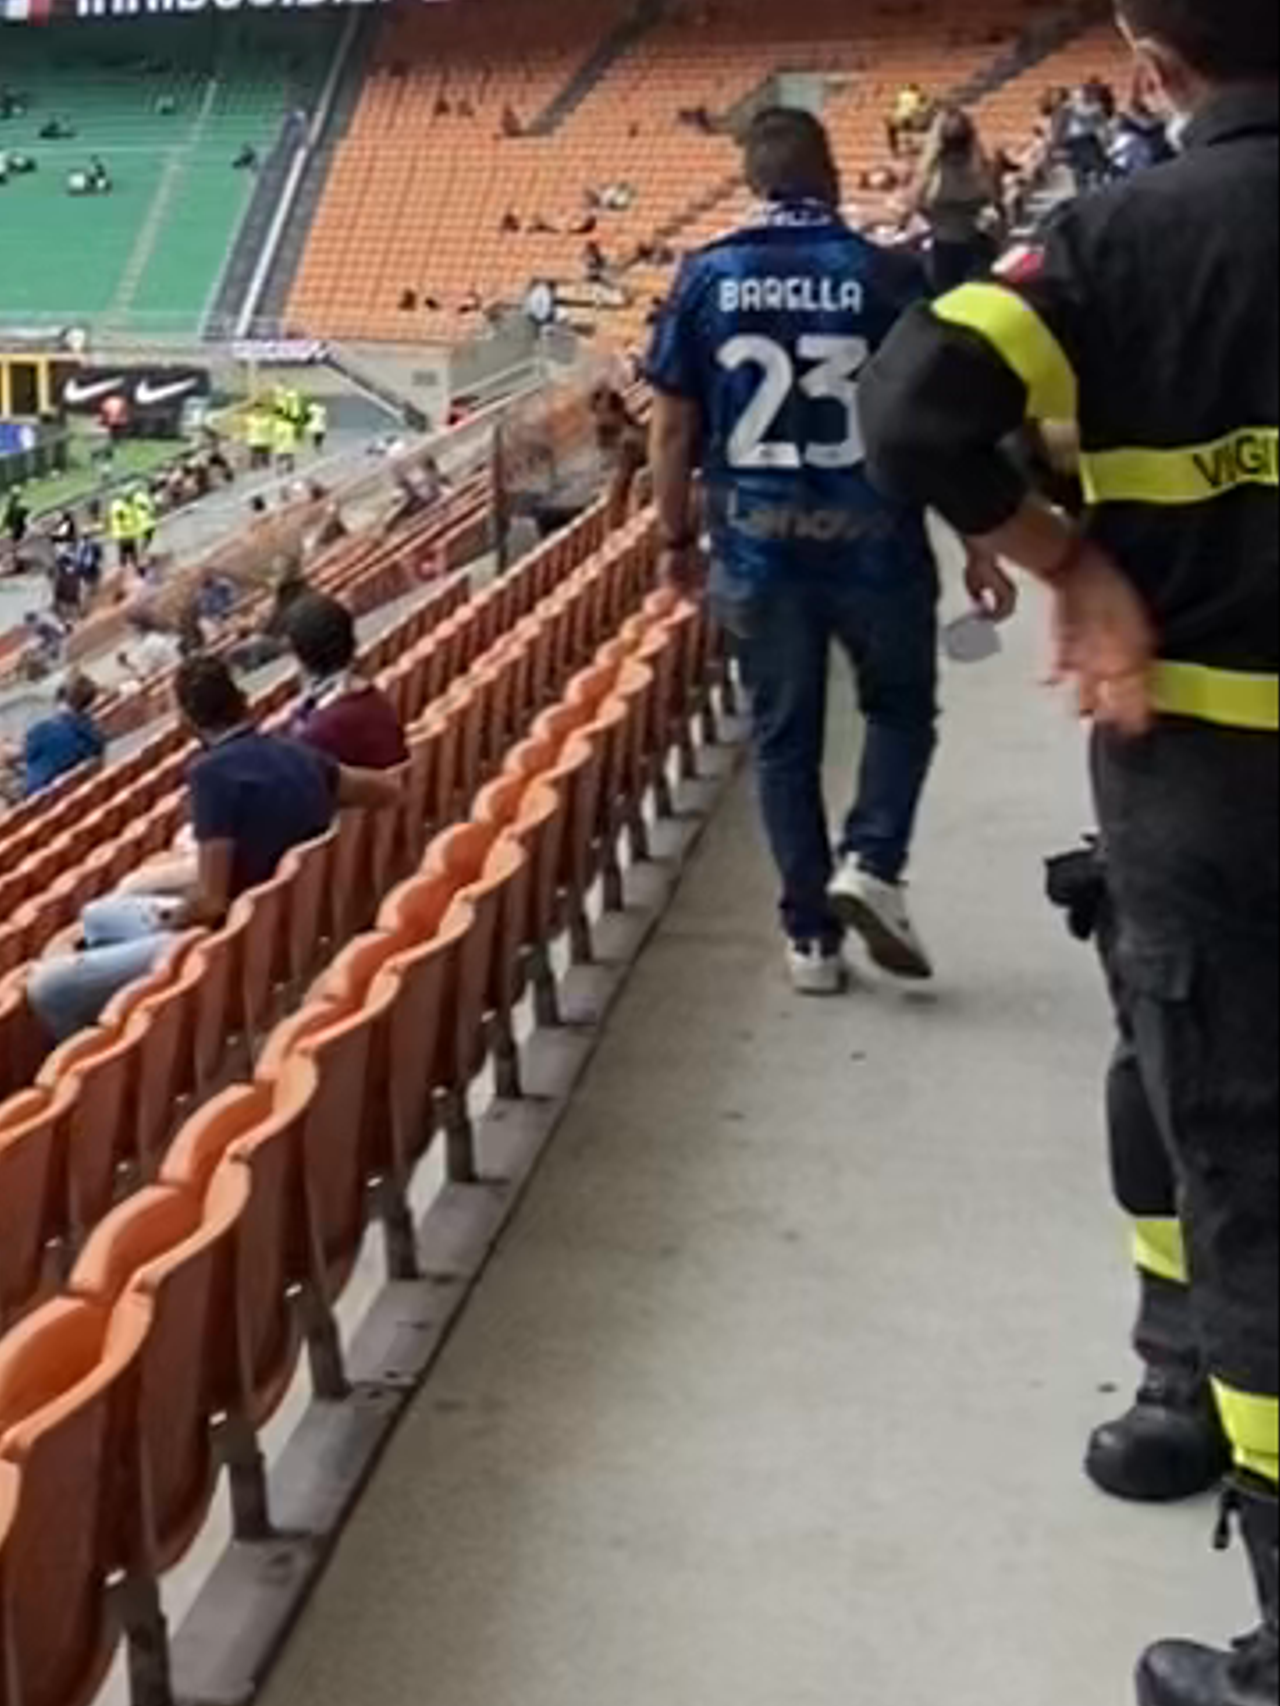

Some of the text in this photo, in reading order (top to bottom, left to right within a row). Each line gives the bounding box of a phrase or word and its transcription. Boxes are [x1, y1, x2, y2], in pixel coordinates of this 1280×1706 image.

[718, 274, 864, 314] BARELLA
[714, 332, 871, 470] 23
[1191, 434, 1279, 491] VIGI
